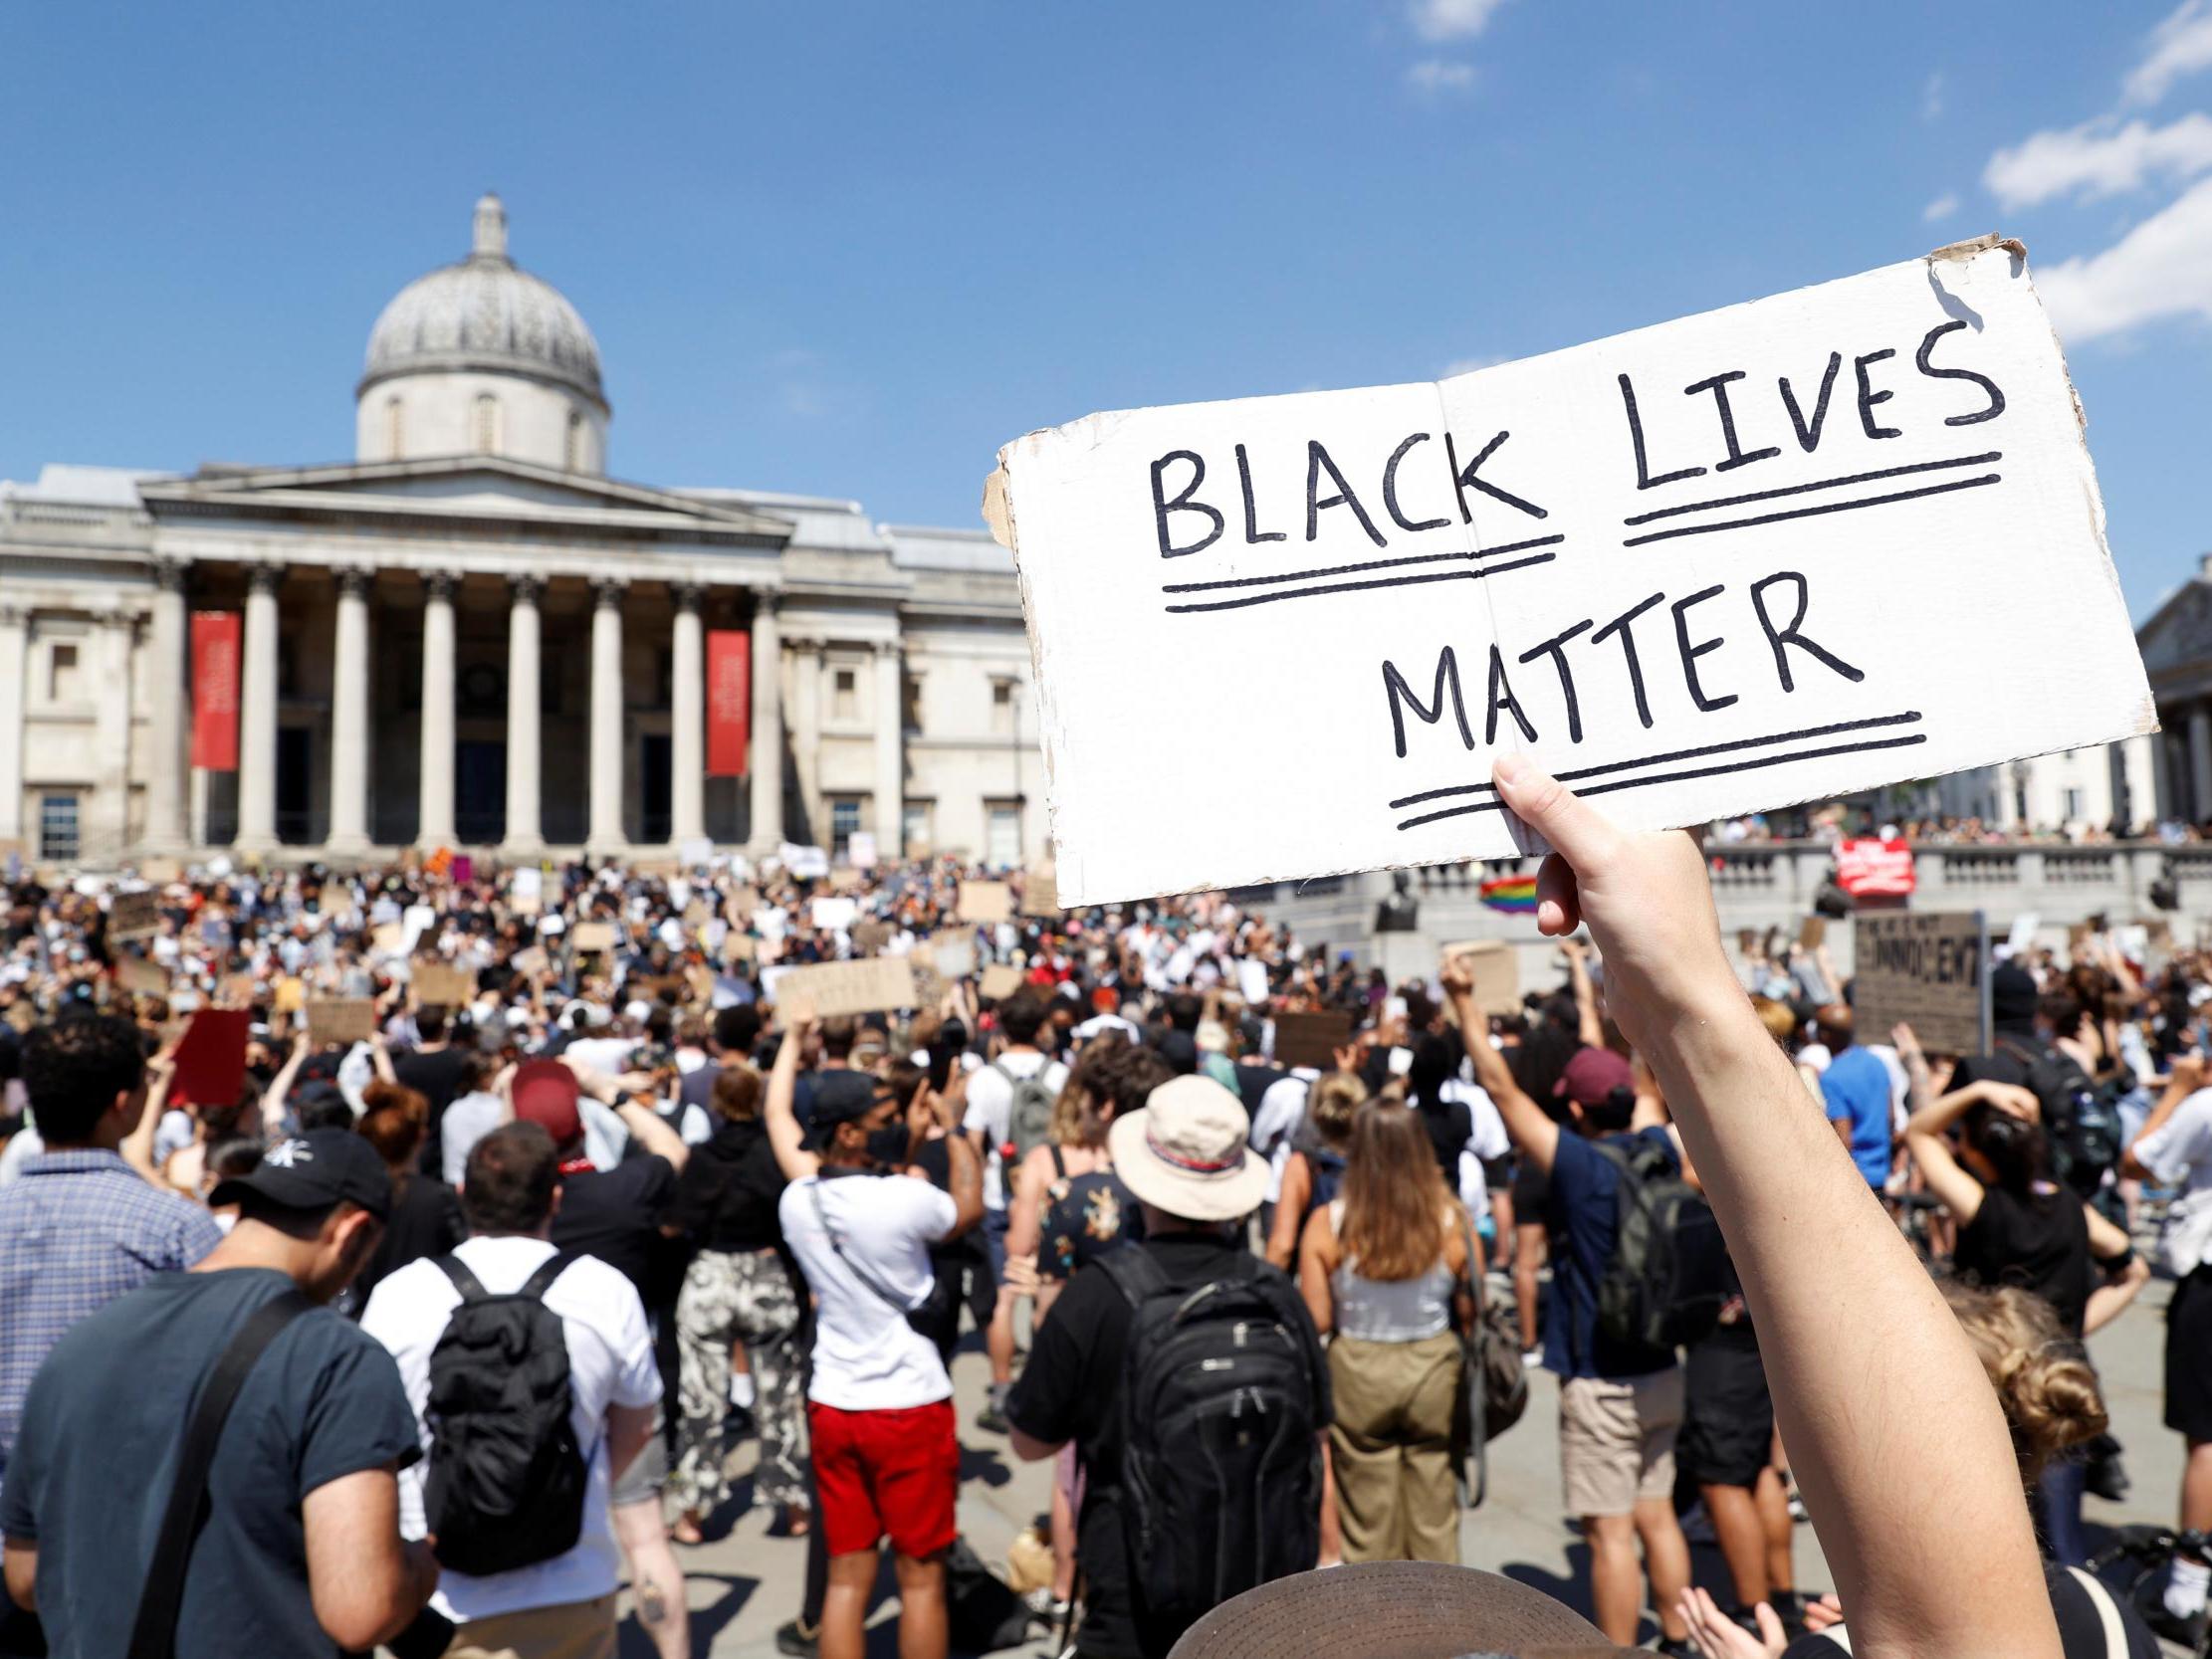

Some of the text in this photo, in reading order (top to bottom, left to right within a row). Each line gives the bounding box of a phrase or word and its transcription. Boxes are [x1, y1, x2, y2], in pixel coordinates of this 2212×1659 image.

[1151, 320, 2006, 557] BLACK LIVES
[1382, 571, 1865, 757] MATTER
